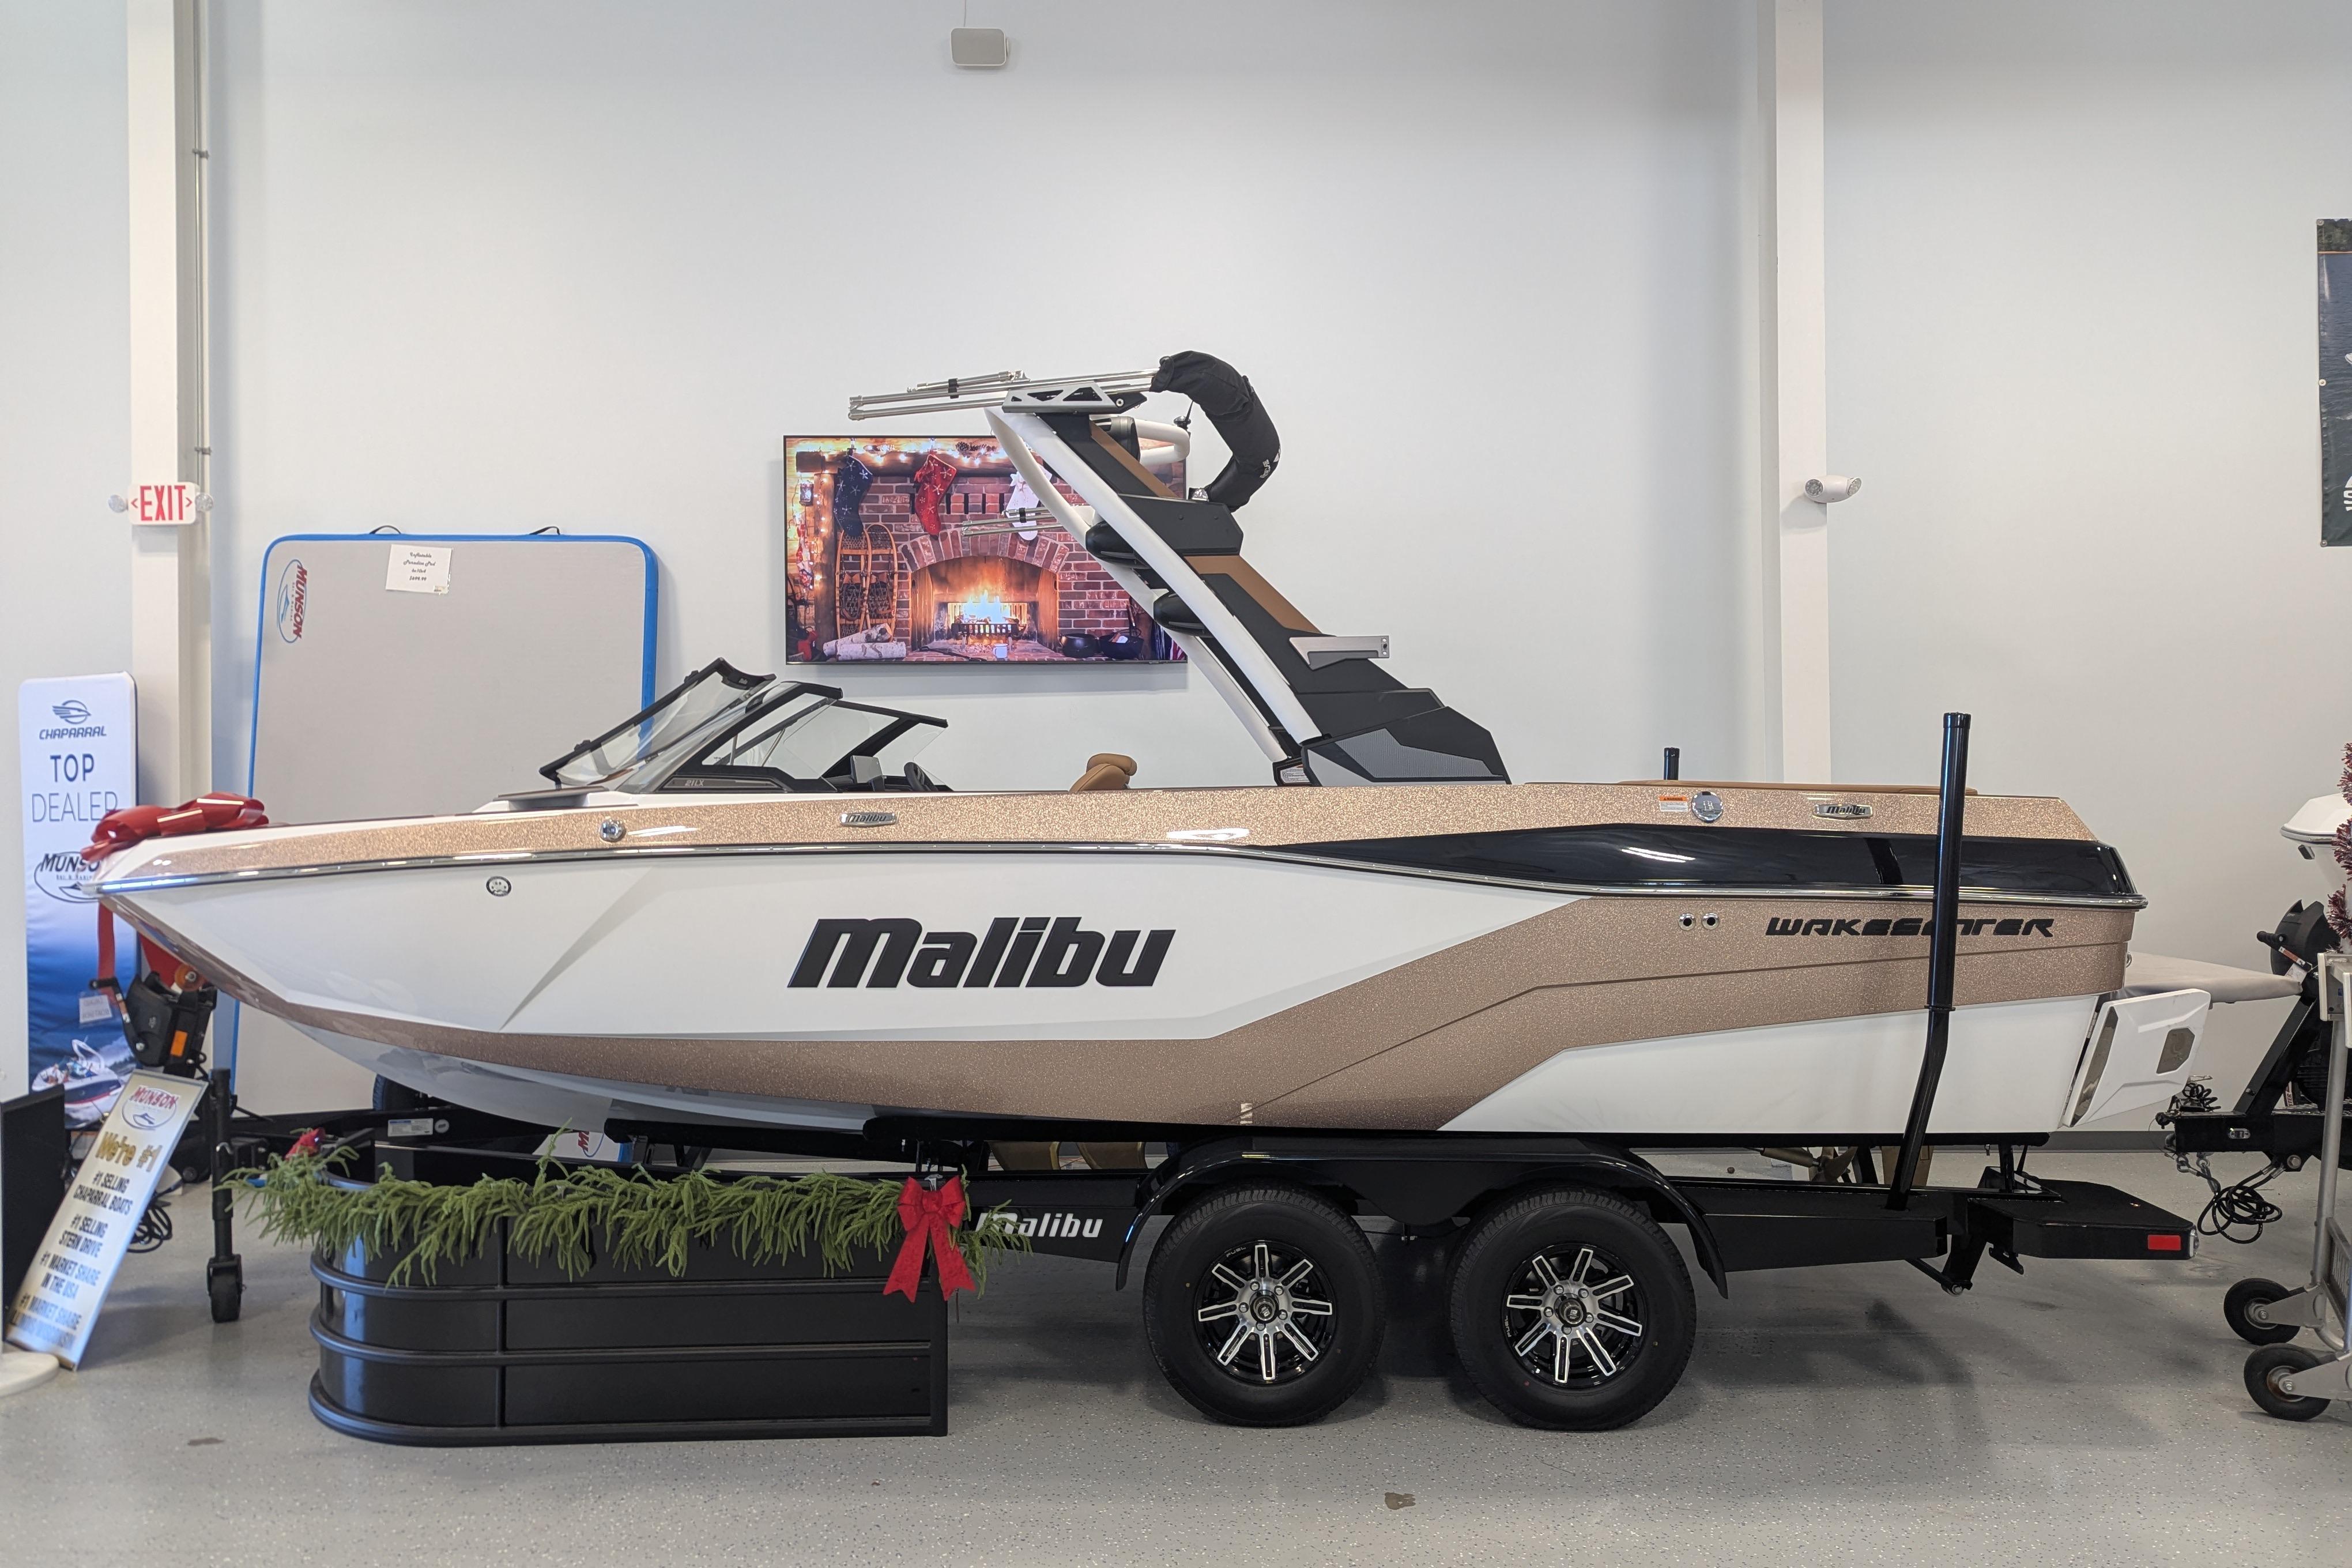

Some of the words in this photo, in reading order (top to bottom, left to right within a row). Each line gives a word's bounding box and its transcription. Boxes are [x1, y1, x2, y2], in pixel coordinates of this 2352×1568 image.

[140, 485, 186, 521] EXIT
[293, 564, 307, 638] MUNSON
[39, 726, 107, 740] CHAPARRAL
[50, 753, 95, 782] TOP
[32, 791, 118, 822] DEALER
[847, 814, 887, 823] Malibu
[1826, 806, 1866, 814] Malibu
[40, 853, 101, 872] MUNSO
[787, 917, 1176, 988] Malibu
[129, 1086, 179, 1109] MUNSON
[136, 1144, 163, 1173] #1
[100, 1173, 130, 1194] SELLING
[73, 1184, 111, 1209] CHAPARRAL
[108, 1195, 133, 1215] BOATS
[79, 1216, 108, 1238] SELLING
[59, 1230, 82, 1250] STERN
[79, 1237, 103, 1258] DRIVE
[48, 1254, 78, 1277] MARKET
